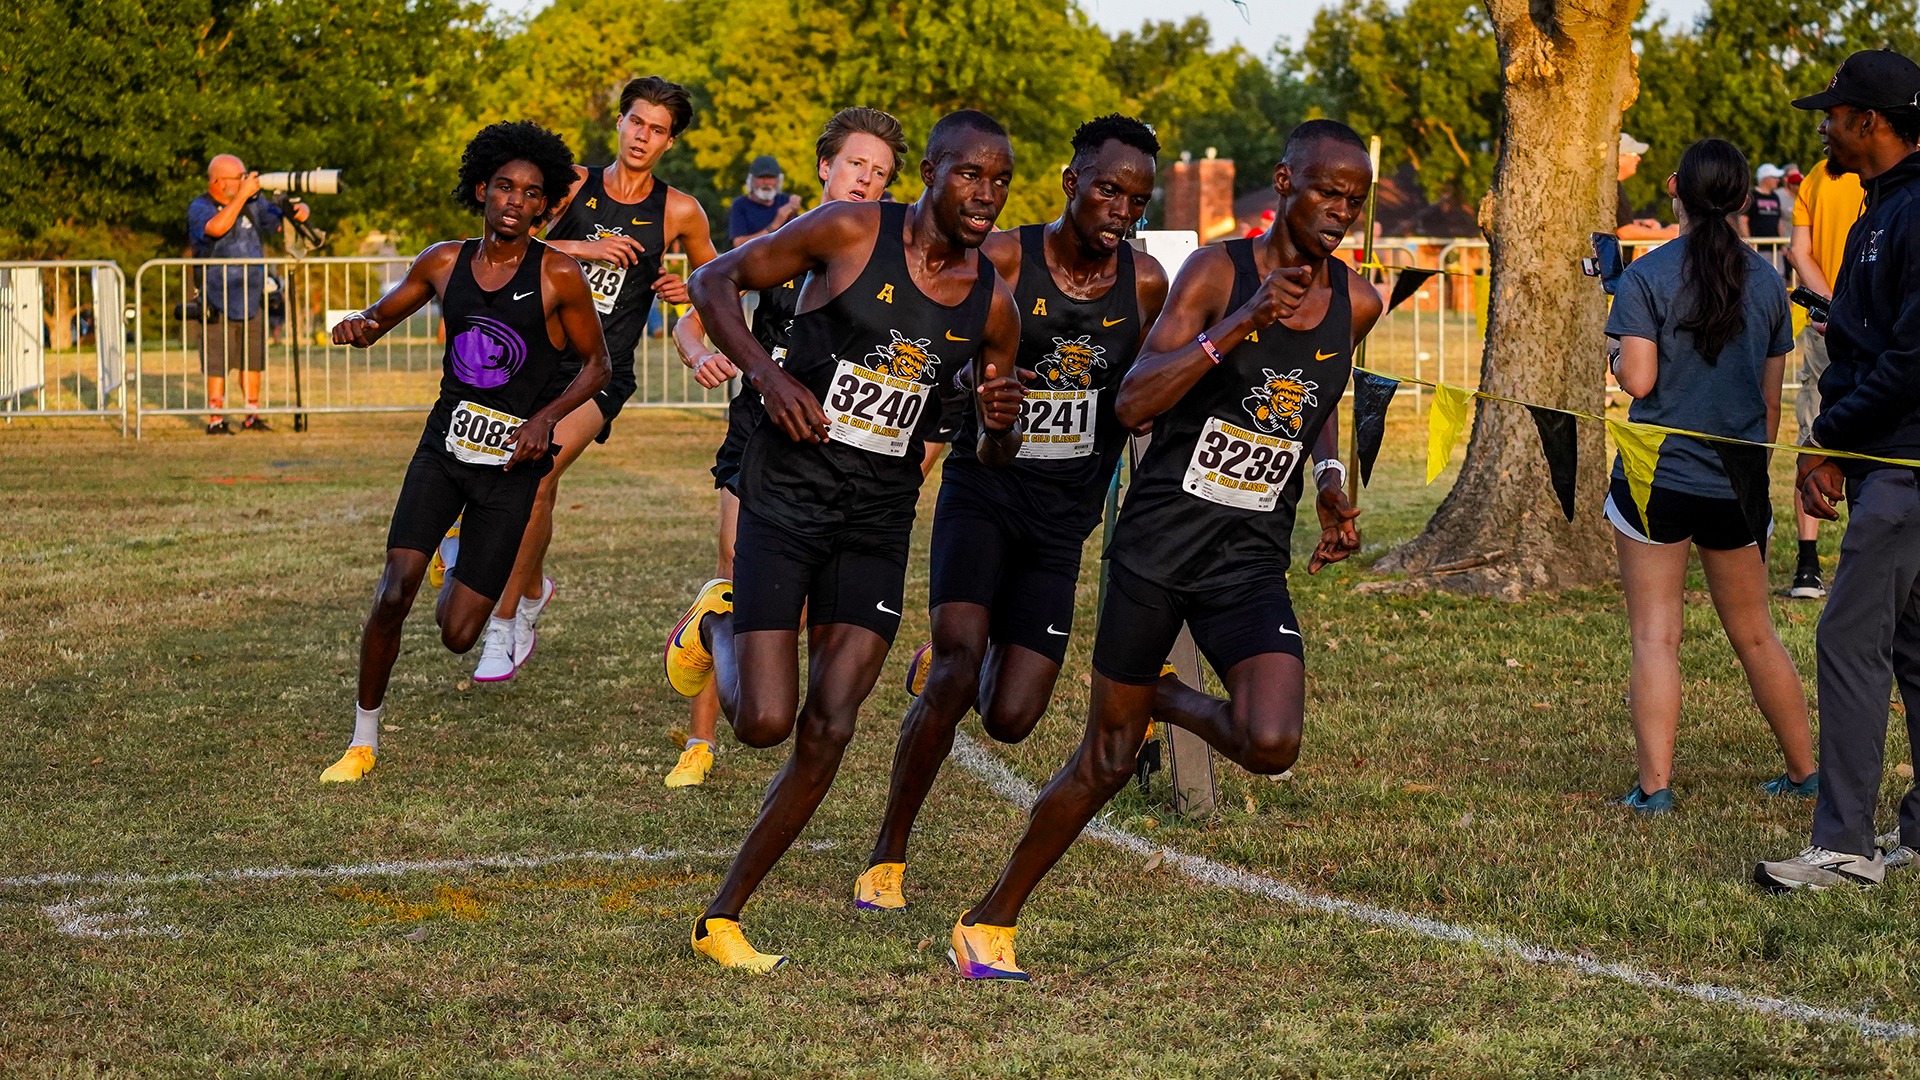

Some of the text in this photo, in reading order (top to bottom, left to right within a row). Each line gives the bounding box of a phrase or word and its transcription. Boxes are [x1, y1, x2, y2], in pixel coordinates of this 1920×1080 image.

[586, 197, 597, 209] A
[877, 283, 894, 304] A
[1033, 297, 1047, 316] A
[852, 365, 885, 384] WICHITA
[886, 377, 910, 391] STATE
[831, 374, 922, 429] 3240
[1053, 392, 1076, 400] STATE
[453, 409, 518, 452] 3082
[837, 414, 850, 425] JK
[850, 417, 872, 431] GOLD
[872, 424, 900, 438] CLASSIC
[1221, 423, 1292, 450] WICHITA STATE XC
[1031, 434, 1050, 443] GOLD
[1051, 434, 1081, 443] CLASSIC
[1197, 431, 1294, 484] 3239
[1204, 471, 1218, 482] JK
[1217, 475, 1240, 489] GOLD
[1239, 481, 1269, 493] CLASSIC
